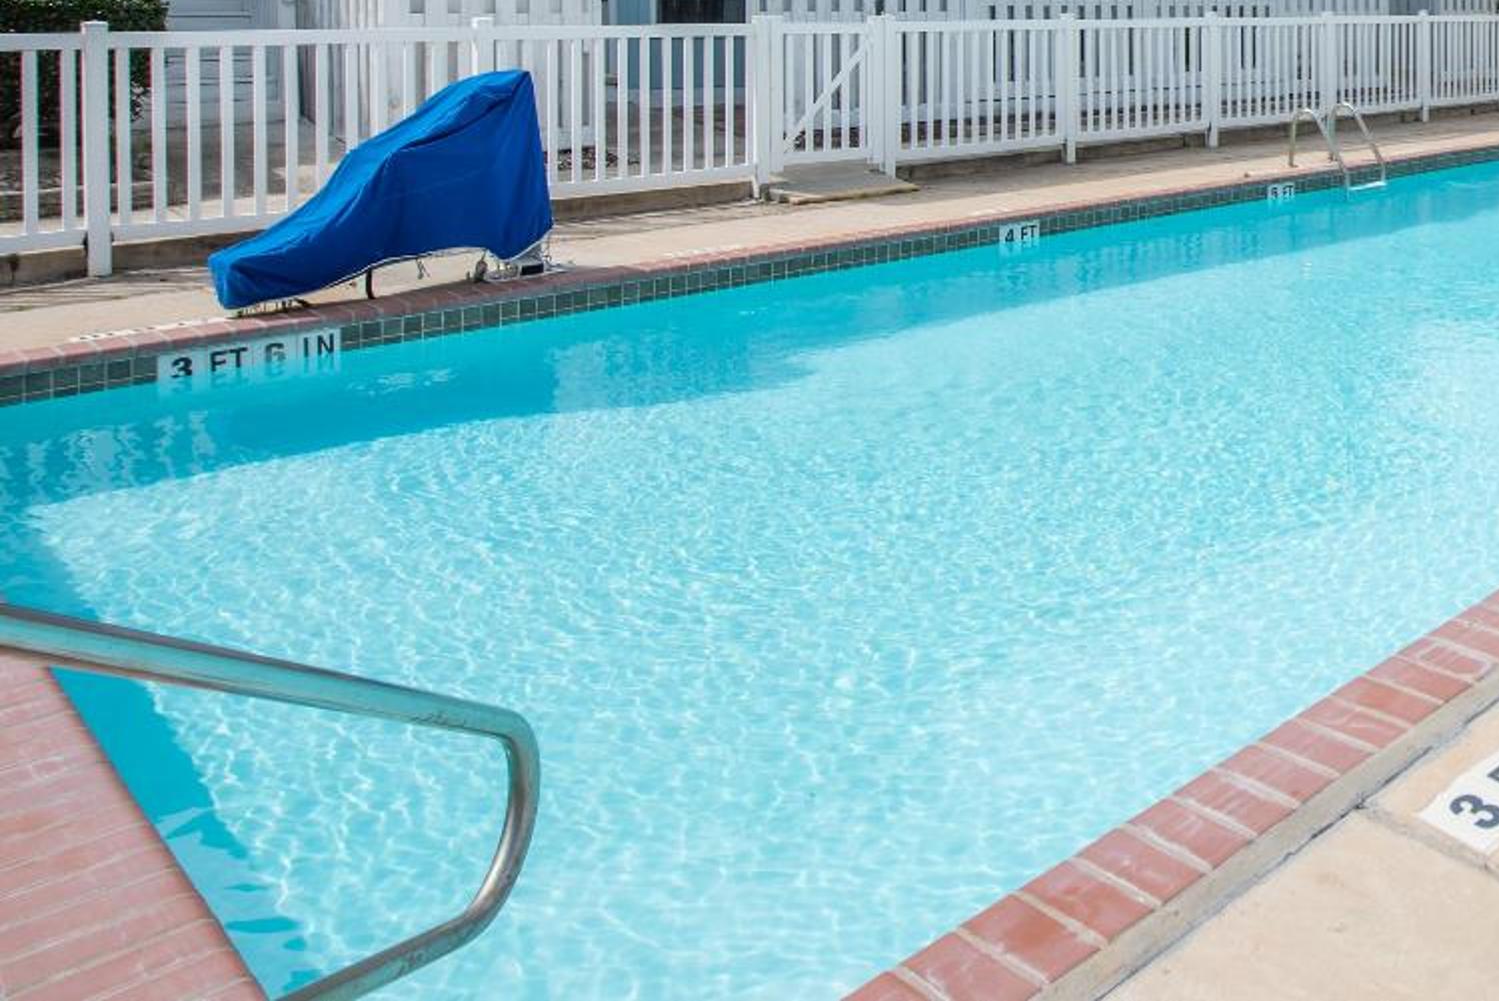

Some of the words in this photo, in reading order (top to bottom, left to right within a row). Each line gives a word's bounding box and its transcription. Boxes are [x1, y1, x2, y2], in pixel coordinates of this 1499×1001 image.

[1005, 229, 1014, 242] 4
[1020, 224, 1038, 240] FT
[171, 356, 193, 379] 3
[210, 347, 248, 373] FT
[303, 333, 334, 359] IN
